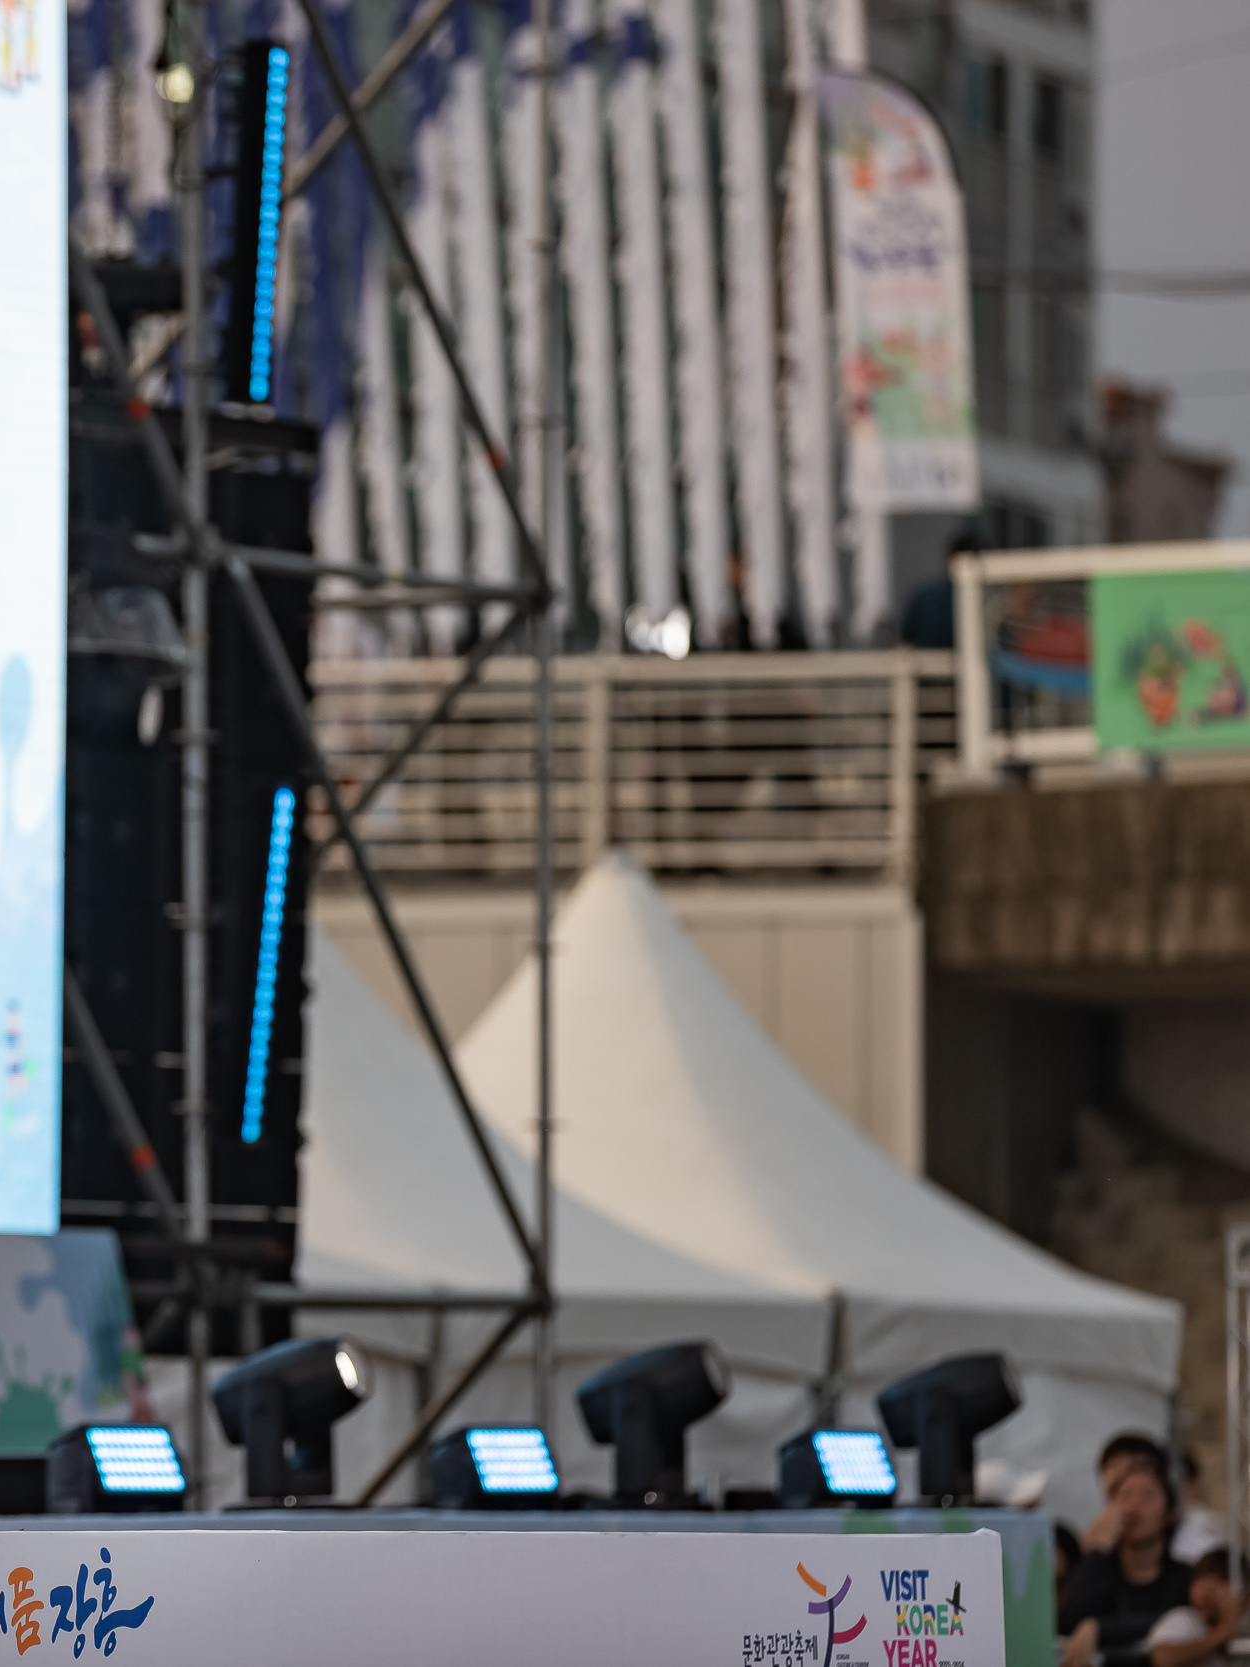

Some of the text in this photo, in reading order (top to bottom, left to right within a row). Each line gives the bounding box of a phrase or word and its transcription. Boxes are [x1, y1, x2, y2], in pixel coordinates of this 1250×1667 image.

[879, 1569, 930, 1601] VISIT
[49, 1546, 155, 1660] 장흥
[896, 1604, 964, 1636] KOREA
[741, 1630, 819, 1667] 문화관광축제
[882, 1639, 938, 1667] YEAR
